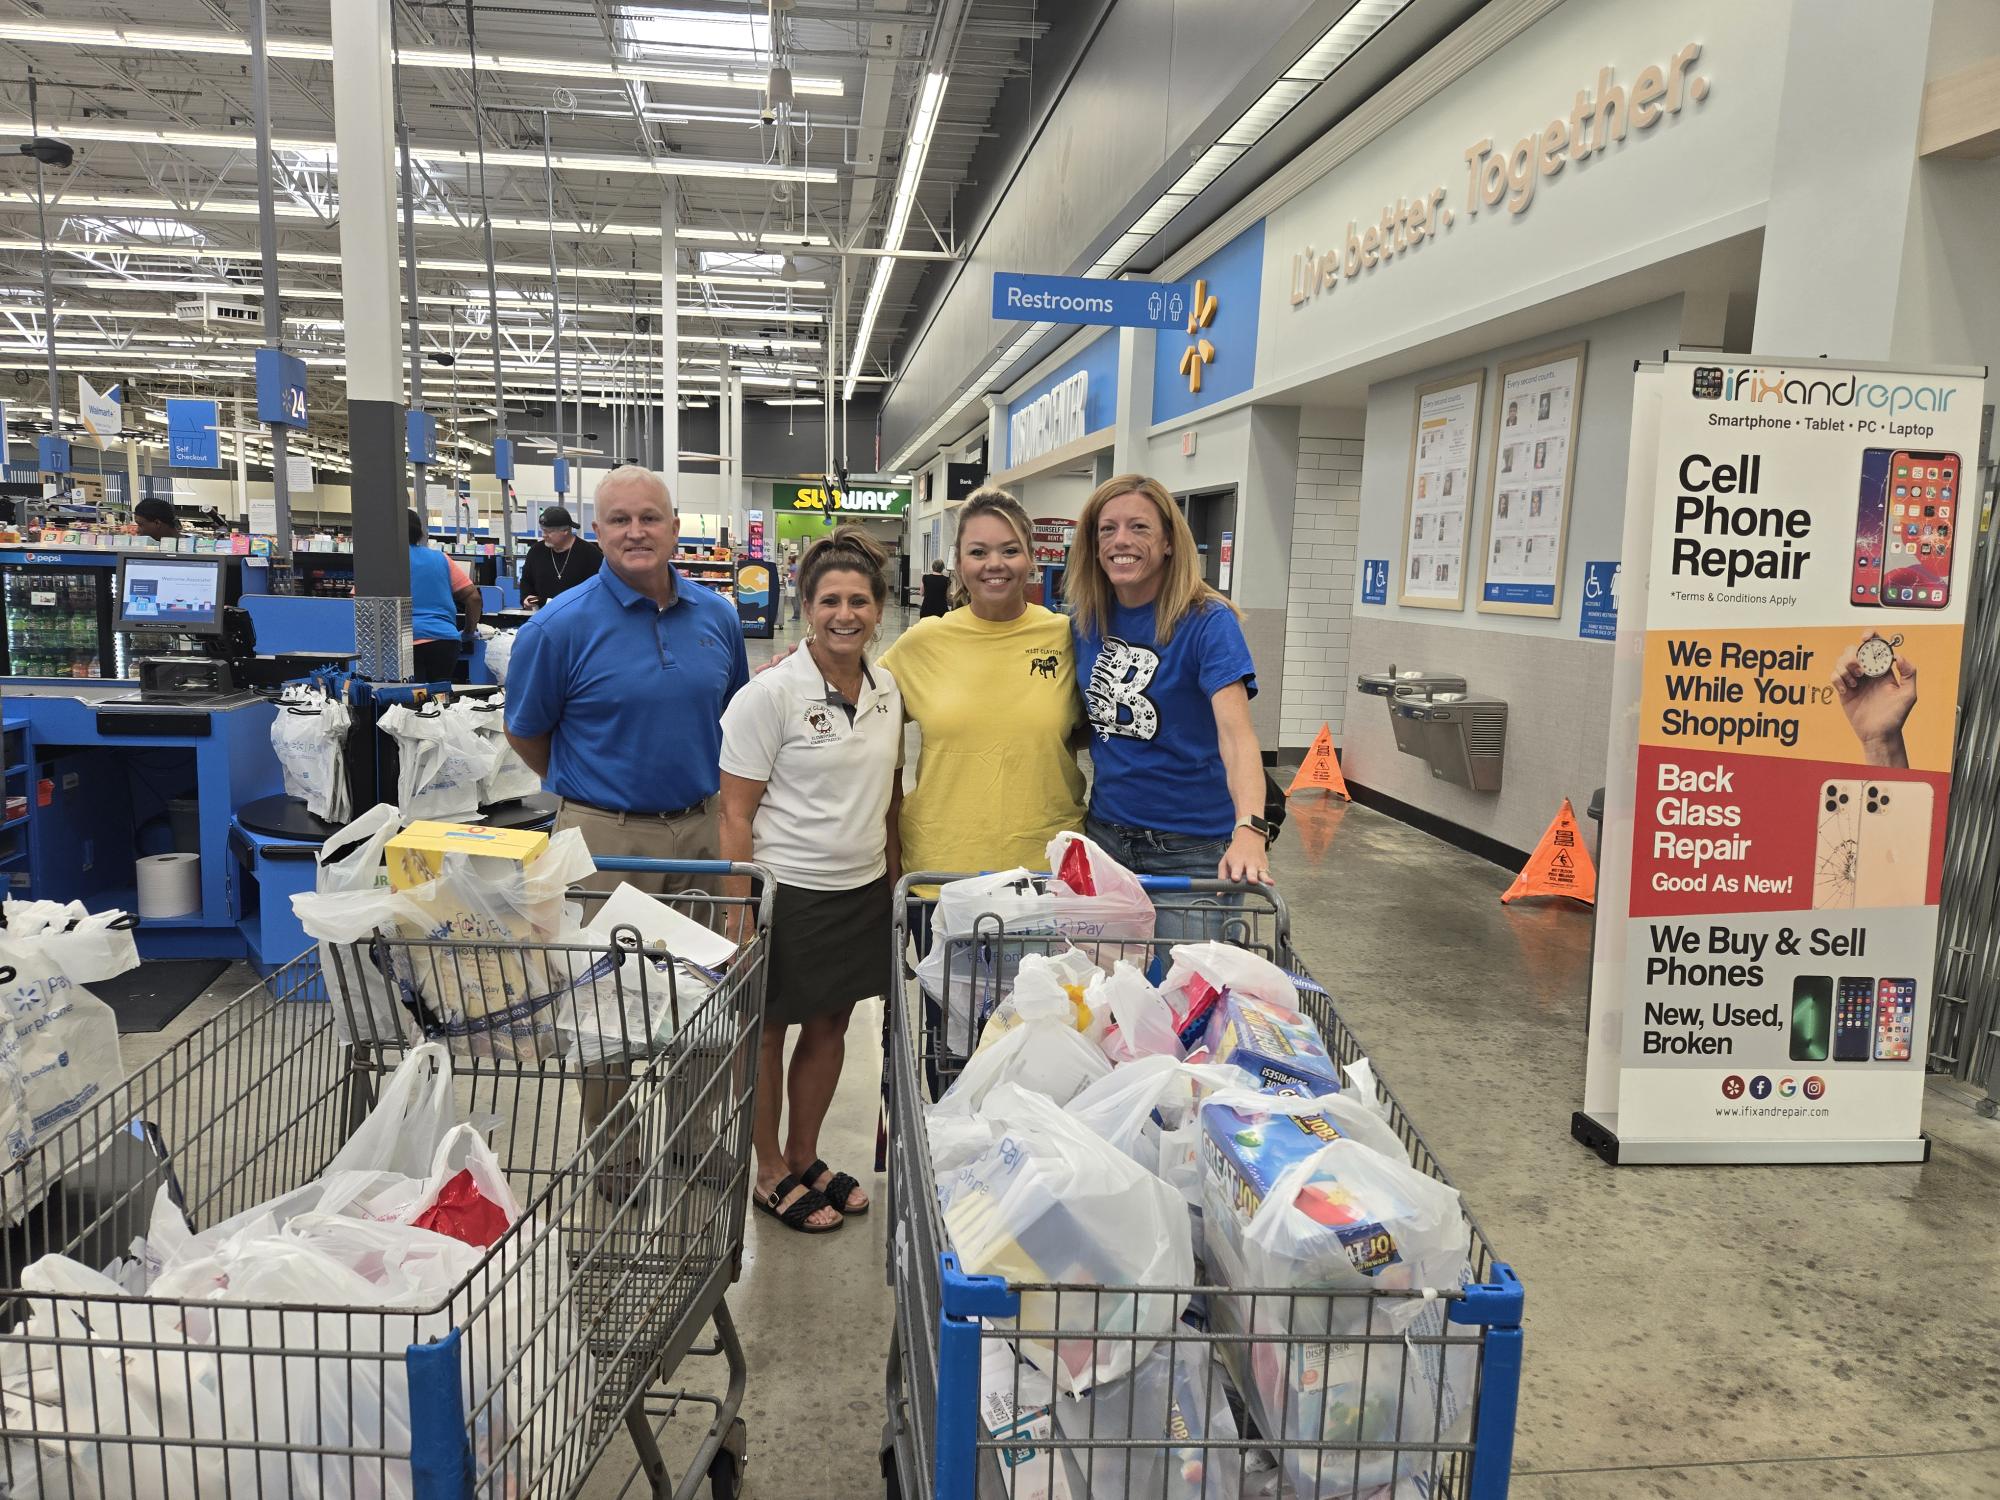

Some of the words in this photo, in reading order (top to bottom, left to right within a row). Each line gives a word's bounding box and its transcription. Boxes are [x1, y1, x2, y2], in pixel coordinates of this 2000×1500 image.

[1290, 244, 1338, 305] Live
[1344, 184, 1455, 279] better.
[1464, 42, 1710, 215] Together.
[1007, 287, 1113, 313] Restrooms
[291, 387, 306, 419] 24
[1725, 368, 1957, 416] ifixandrepair
[1708, 413, 1791, 430] Smartphone
[1804, 417, 1844, 432] Tablet
[1858, 420, 1877, 432] PC
[1889, 422, 1934, 438] Laptop
[52, 453, 62, 468] 17
[176, 445, 190, 453] Self
[176, 453, 208, 461] Checkout
[1679, 454, 1760, 494] Cell
[1675, 495, 1811, 538] Phone
[37, 554, 61, 563] pepsi
[1672, 538, 1811, 587] Repair
[1708, 593, 1714, 602] &
[1717, 593, 1767, 604] Conditions
[1769, 594, 1796, 606] Apply
[1668, 640, 1712, 667] We
[1721, 642, 1814, 678] Repair
[1665, 675, 1743, 704] While
[1661, 708, 1799, 747] Shopping
[1657, 763, 1734, 792] Back
[1656, 797, 1741, 827] Glass
[1653, 831, 1752, 868] Repair
[1651, 872, 1707, 892] Good
[1712, 874, 1738, 892] As
[1743, 875, 1793, 894] New!
[1076, 921, 1105, 937] Pay
[1650, 925, 1700, 954] We
[1708, 926, 1769, 962] Buy
[1775, 927, 1802, 956] &
[1809, 928, 1866, 957] Sell
[47, 975, 72, 994] Pay
[1646, 957, 1764, 987] Phones
[1644, 1002, 1704, 1030] New,
[1712, 1003, 1783, 1031] Used,
[1643, 1031, 1733, 1055] Broken
[1715, 1106, 1829, 1119] www.ifixandrepair.com
[999, 1137, 1024, 1175] Pay
